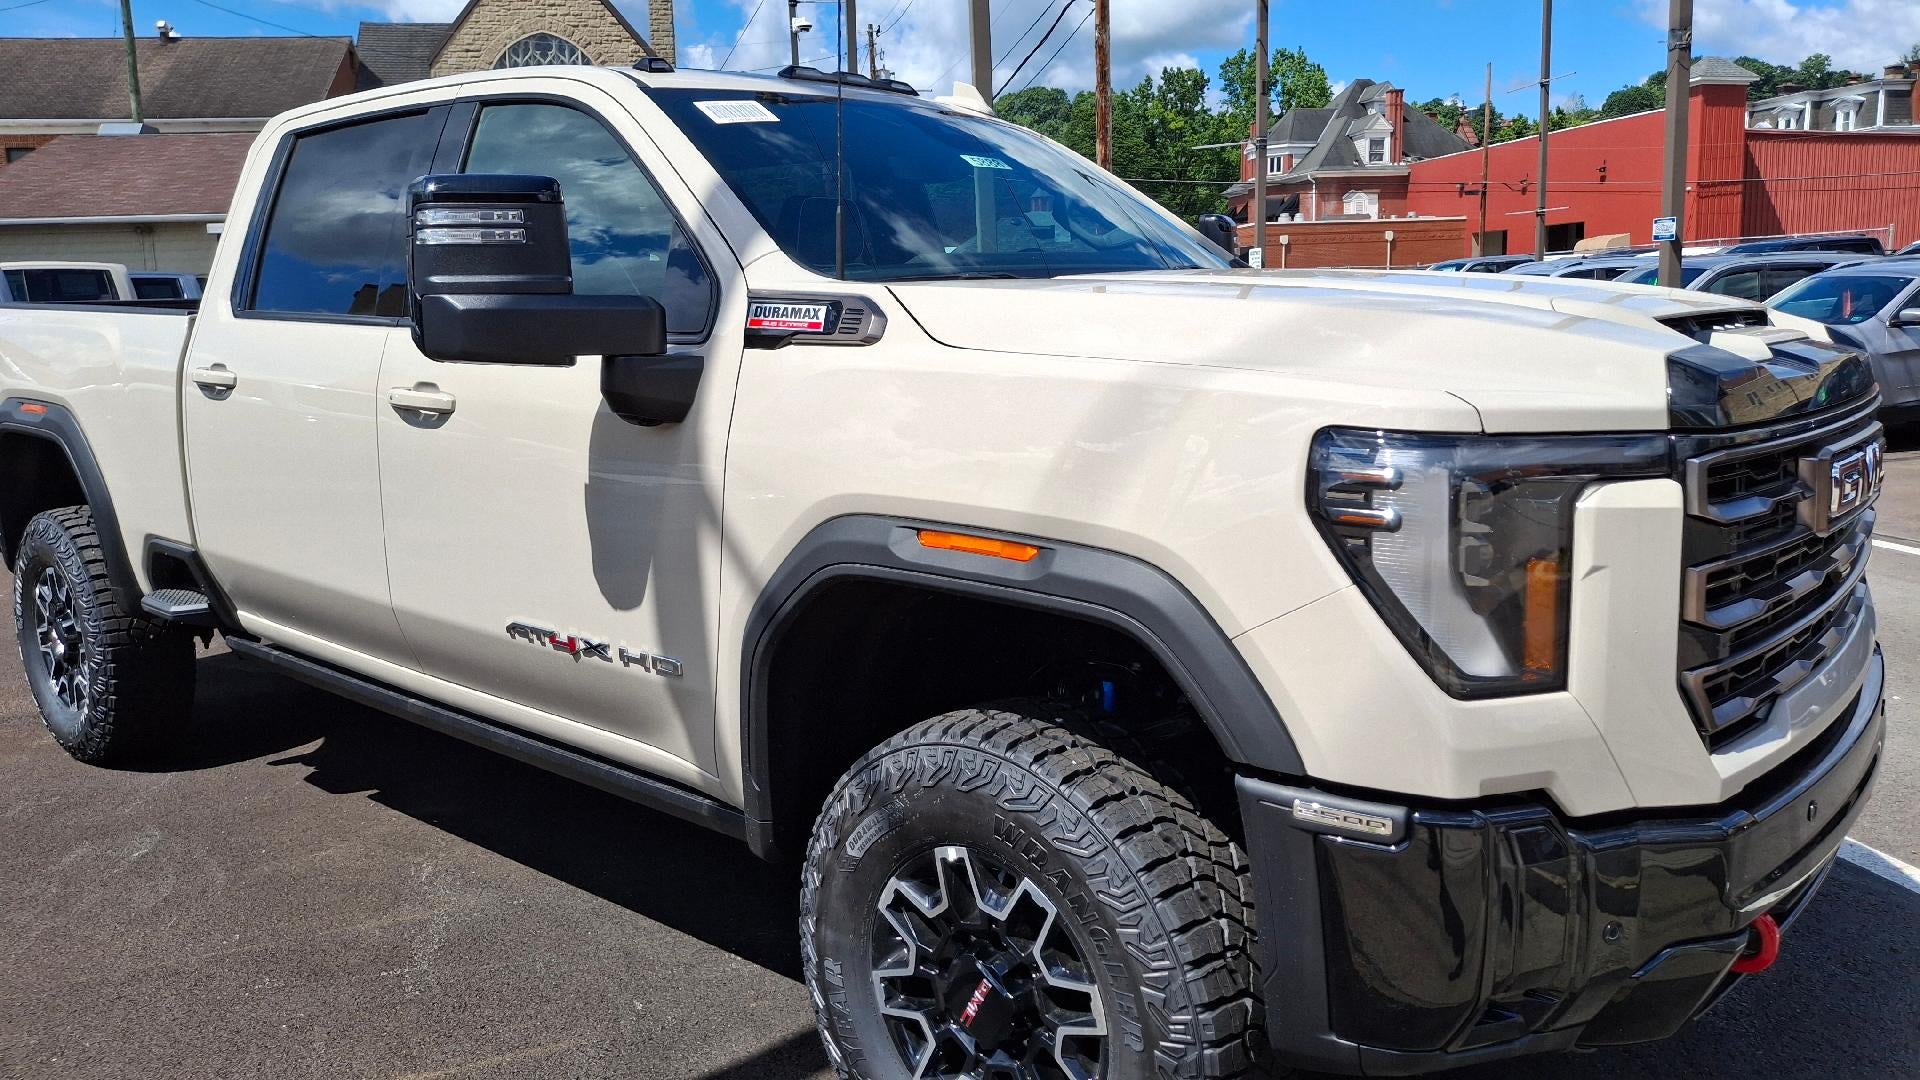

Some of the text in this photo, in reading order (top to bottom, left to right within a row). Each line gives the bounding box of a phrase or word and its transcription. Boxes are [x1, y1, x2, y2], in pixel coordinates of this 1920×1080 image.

[753, 305, 821, 320] DURAMAX
[780, 320, 809, 328] LITER
[618, 646, 683, 677] HD
[1297, 805, 1387, 830] 2500
[993, 813, 1145, 1052] WRANGLER
